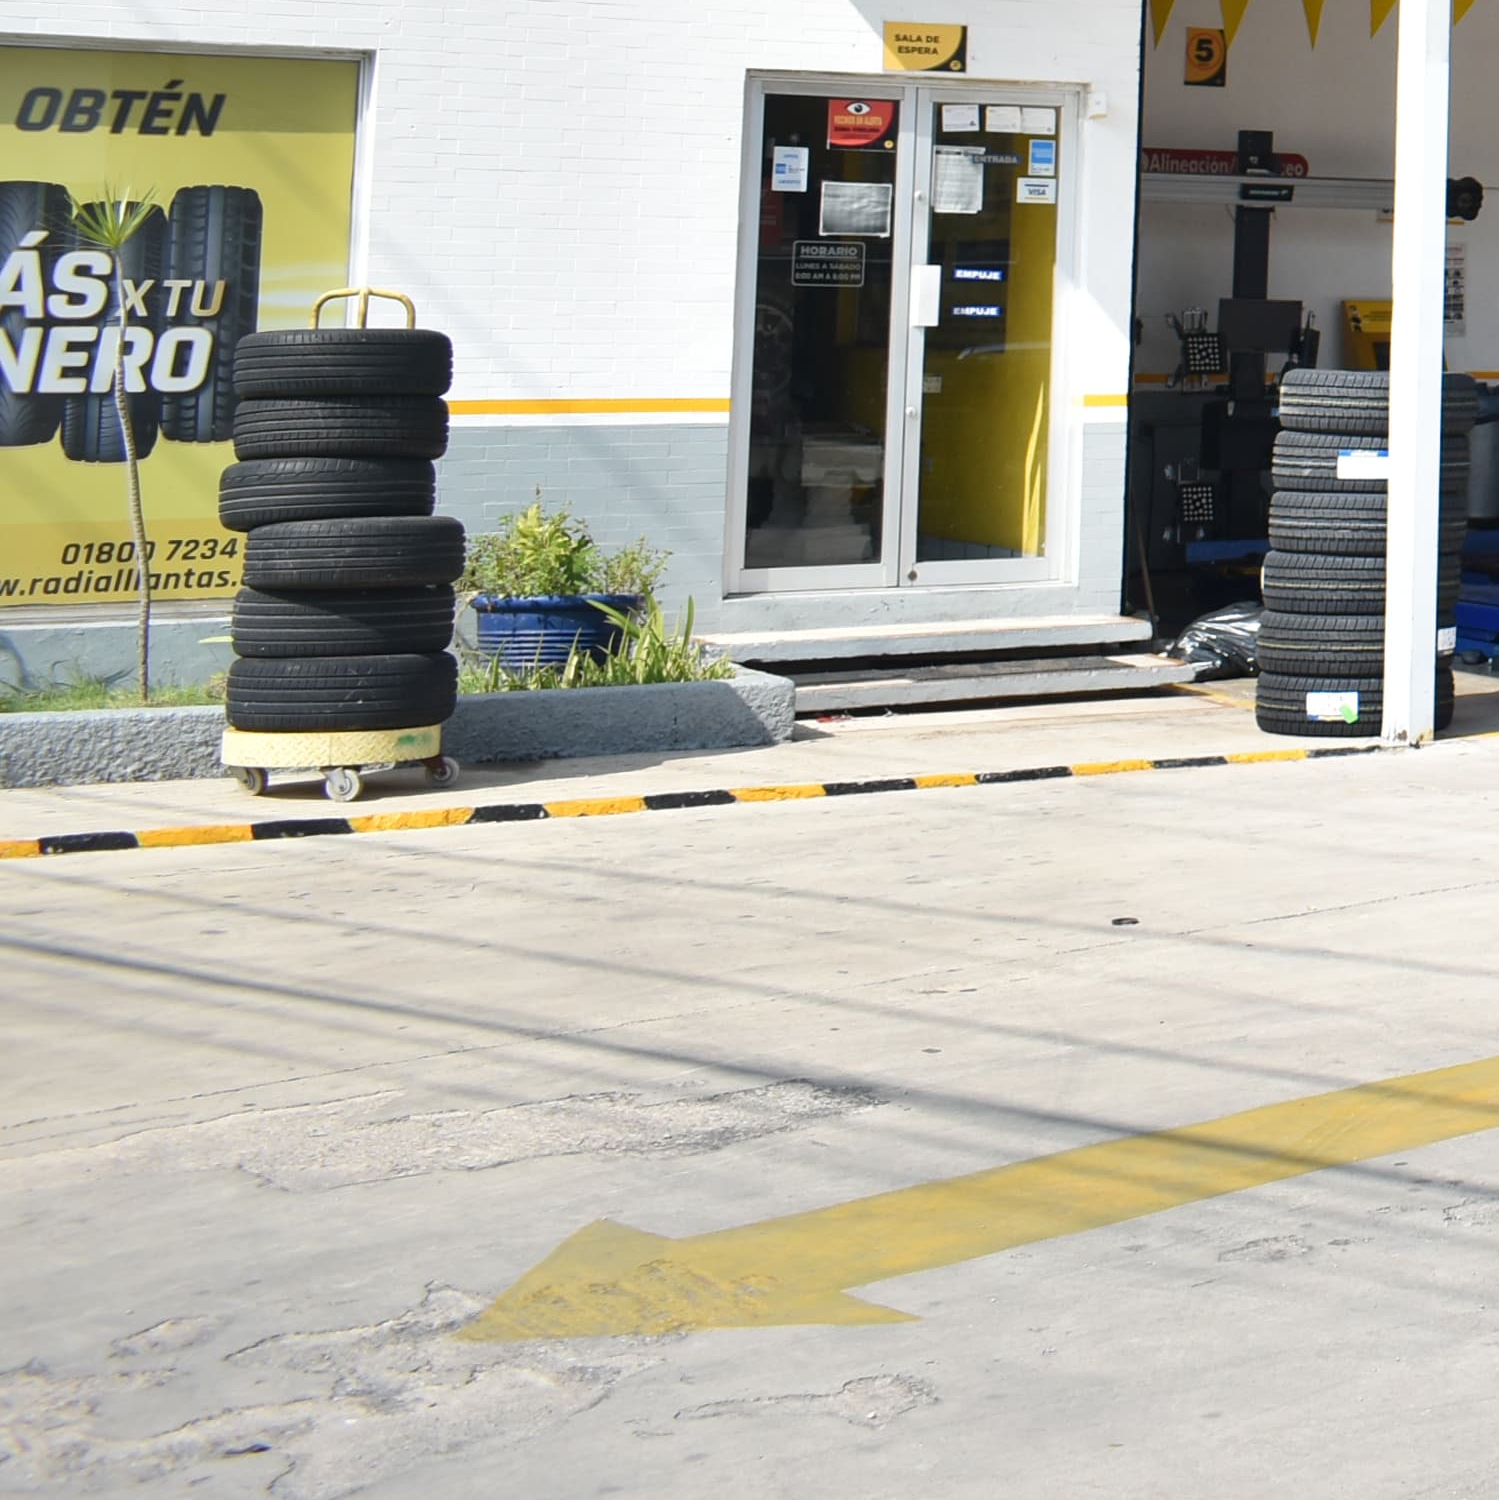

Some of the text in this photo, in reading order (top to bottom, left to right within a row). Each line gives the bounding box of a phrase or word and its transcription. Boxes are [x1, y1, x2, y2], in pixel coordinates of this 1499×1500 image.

[895, 34, 940, 44] SALA DE
[898, 46, 939, 56] ESPERA
[1194, 38, 1214, 63] 5
[15, 79, 227, 137] OBTÉN
[974, 155, 1018, 164] ENTRADA
[800, 245, 858, 256] HORARIO
[955, 270, 1000, 280] EMPUJE
[163, 279, 227, 317] TU
[953, 307, 997, 316] EMPUJE
[165, 537, 238, 561] 7234
